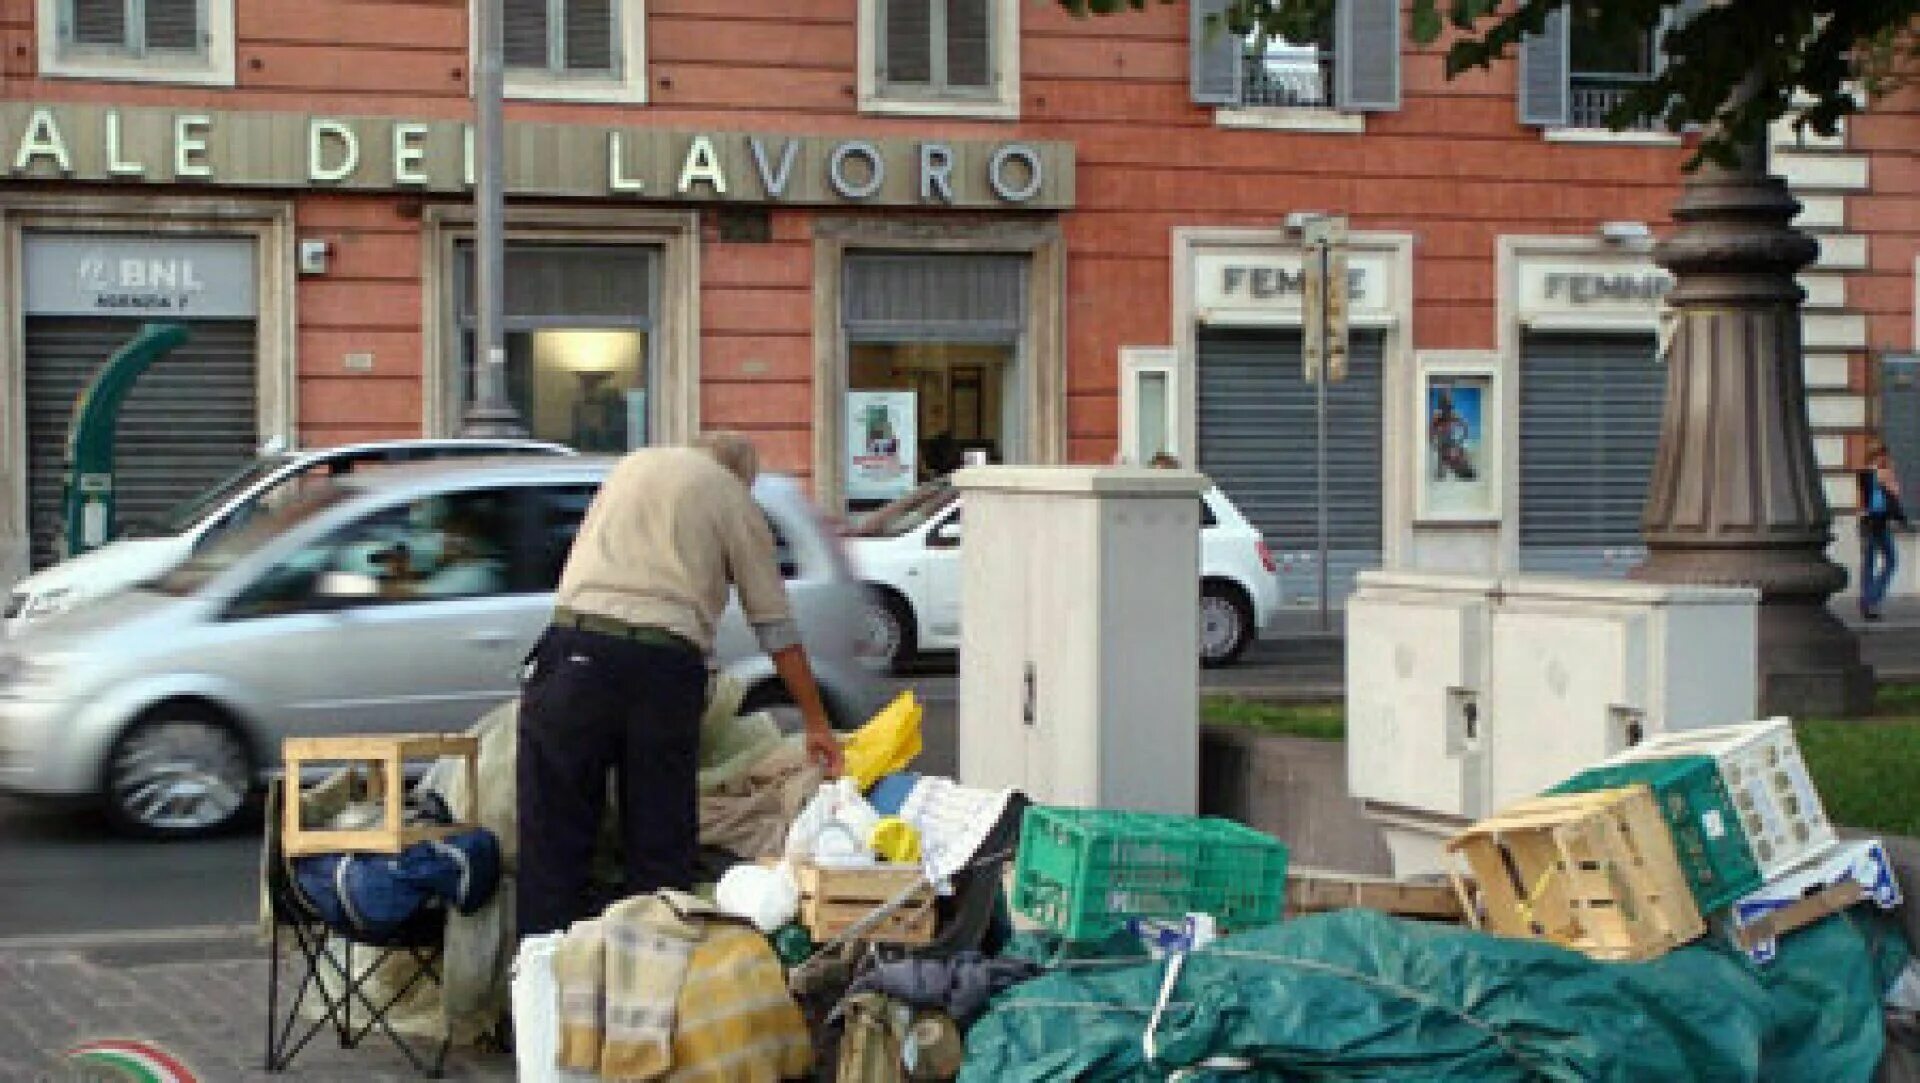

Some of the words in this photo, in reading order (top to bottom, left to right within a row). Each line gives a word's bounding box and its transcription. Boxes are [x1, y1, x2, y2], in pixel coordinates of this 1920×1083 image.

[13, 107, 211, 177] ALE
[608, 131, 1042, 200] LAVORO
[119, 258, 206, 290] BNL
[1223, 266, 1366, 299] FEME
